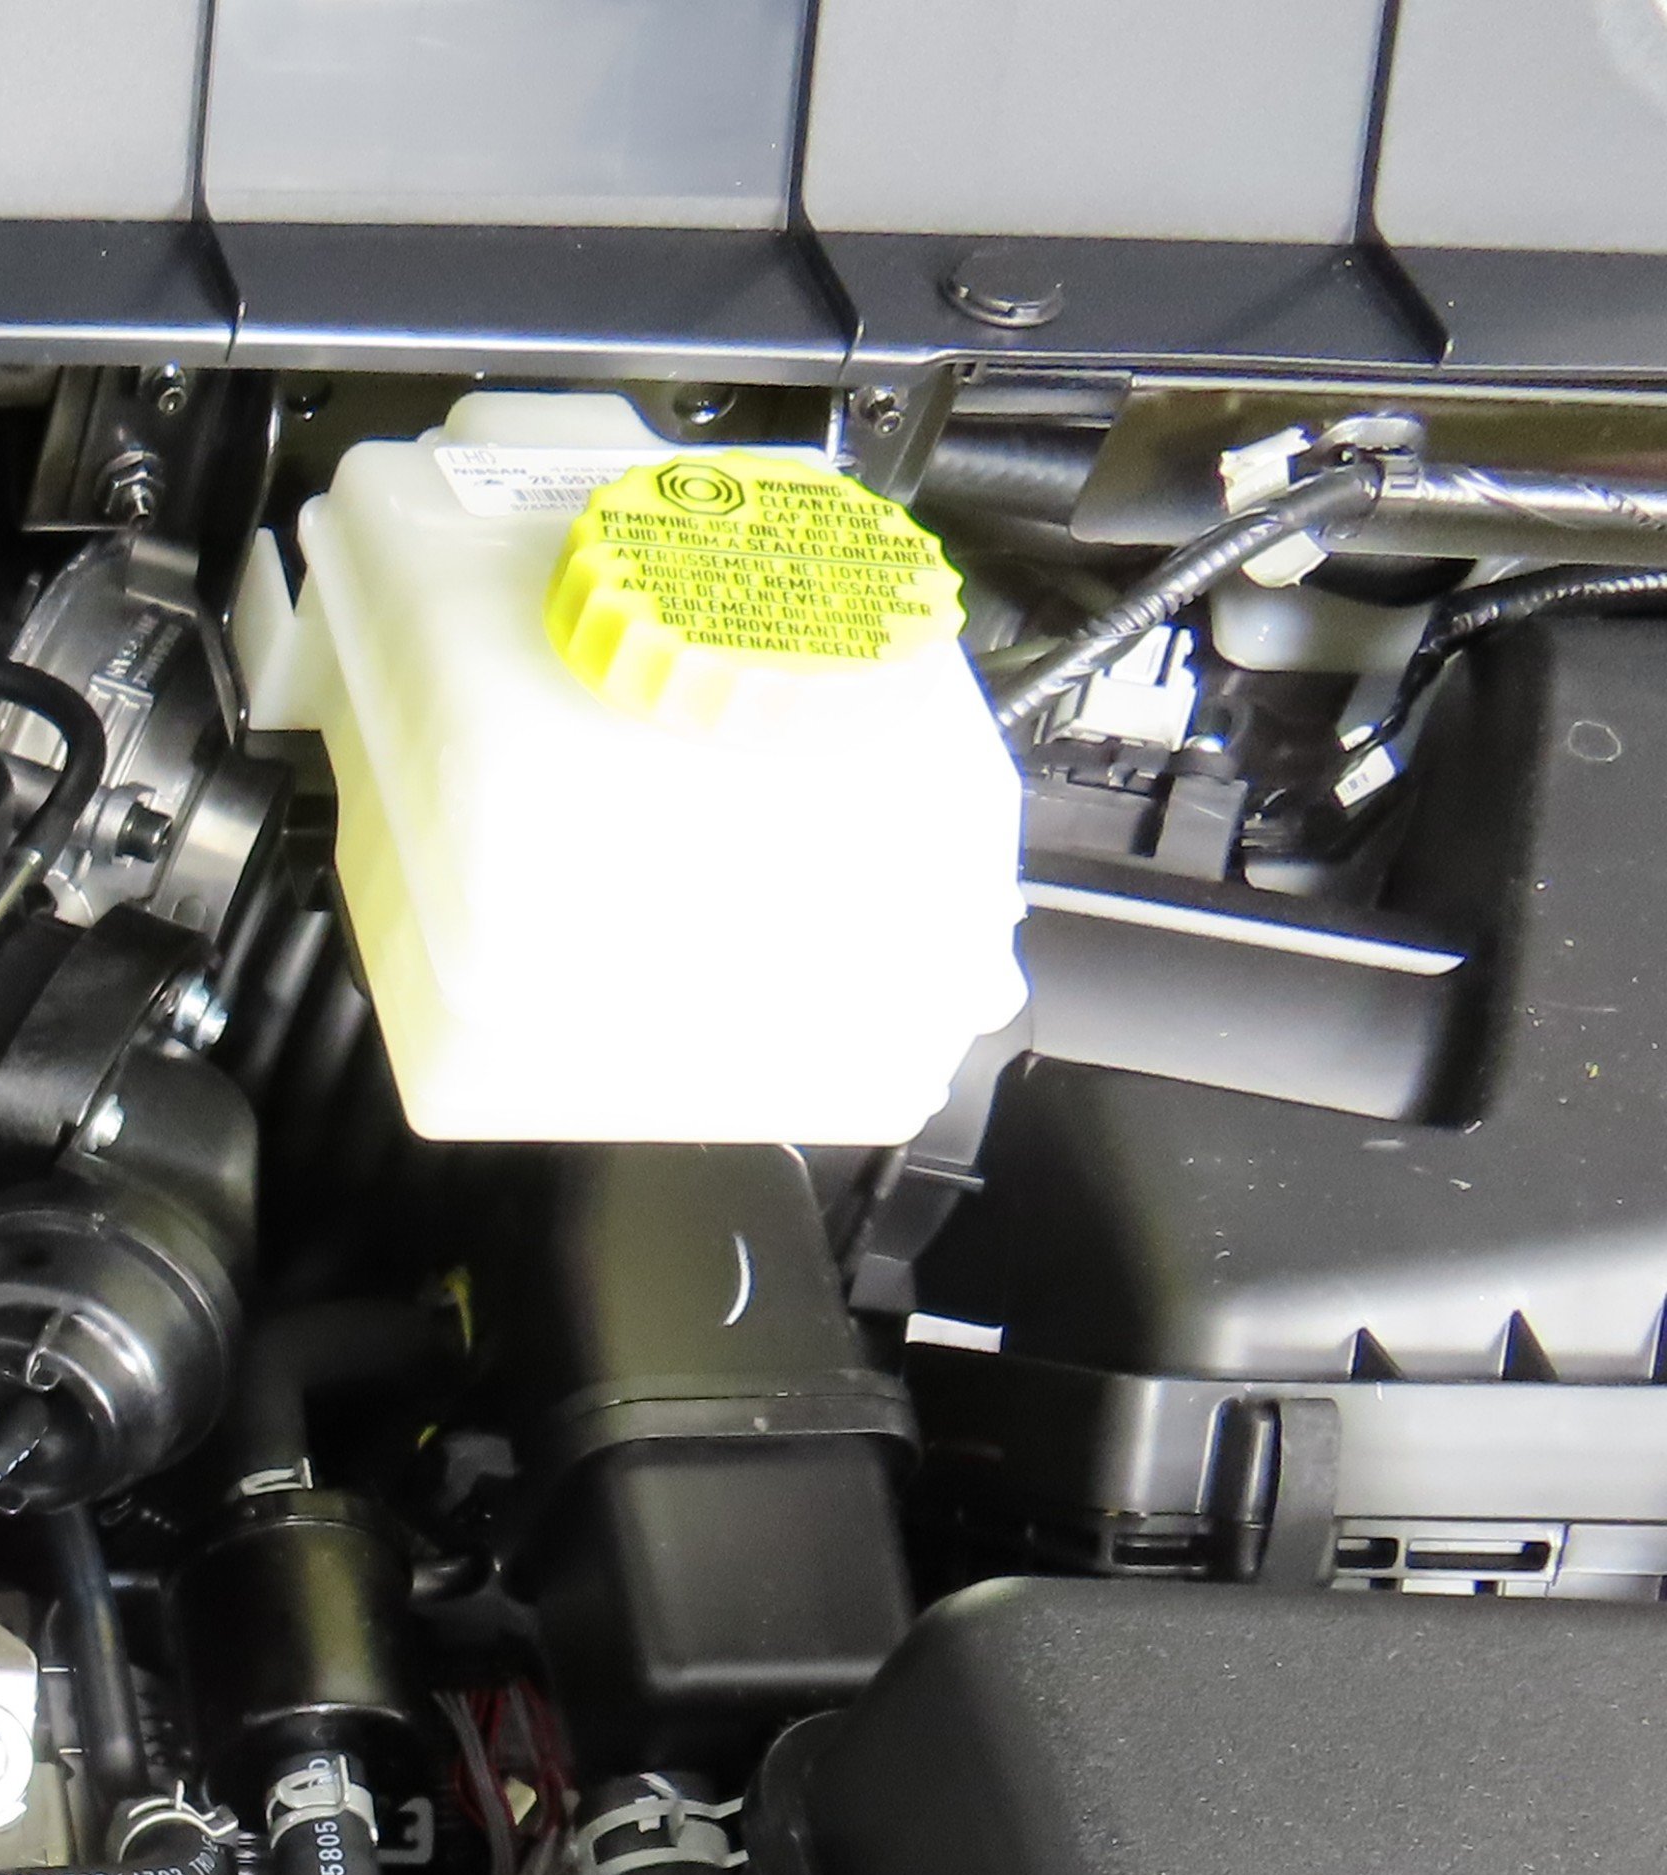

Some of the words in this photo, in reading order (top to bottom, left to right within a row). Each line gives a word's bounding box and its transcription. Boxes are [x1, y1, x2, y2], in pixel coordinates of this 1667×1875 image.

[759, 495, 824, 511] CLEAN
[829, 501, 894, 518] FILLER
[709, 521, 744, 535] USE
[749, 524, 797, 540] ONLY
[805, 529, 838, 544] DOT
[848, 531, 860, 545] 3
[866, 532, 929, 551] BRAKE
[763, 511, 800, 524] CAP
[811, 513, 883, 532] BEFORE
[603, 525, 658, 542] FLUID
[666, 530, 720, 548] FROM
[728, 537, 740, 549] A
[747, 538, 824, 557] SEALED
[830, 546, 938, 565] CONTAINER
[641, 563, 728, 584] BOUCHON
[734, 572, 757, 587] DE
[763, 575, 902, 599] REMPLISSAGE
[789, 562, 891, 584] NETTOYER
[896, 571, 919, 585] LE
[622, 577, 688, 597] AVANT
[696, 583, 720, 600] DE
[846, 598, 933, 617] UTILISER
[658, 595, 774, 618] SEULEMENT
[782, 606, 806, 621] DU
[813, 610, 886, 628] LIQUIDE
[661, 611, 698, 627] DOT
[706, 616, 717, 630] 3
[723, 617, 839, 640] PROVENANT
[685, 630, 800, 653] CONTENANT
